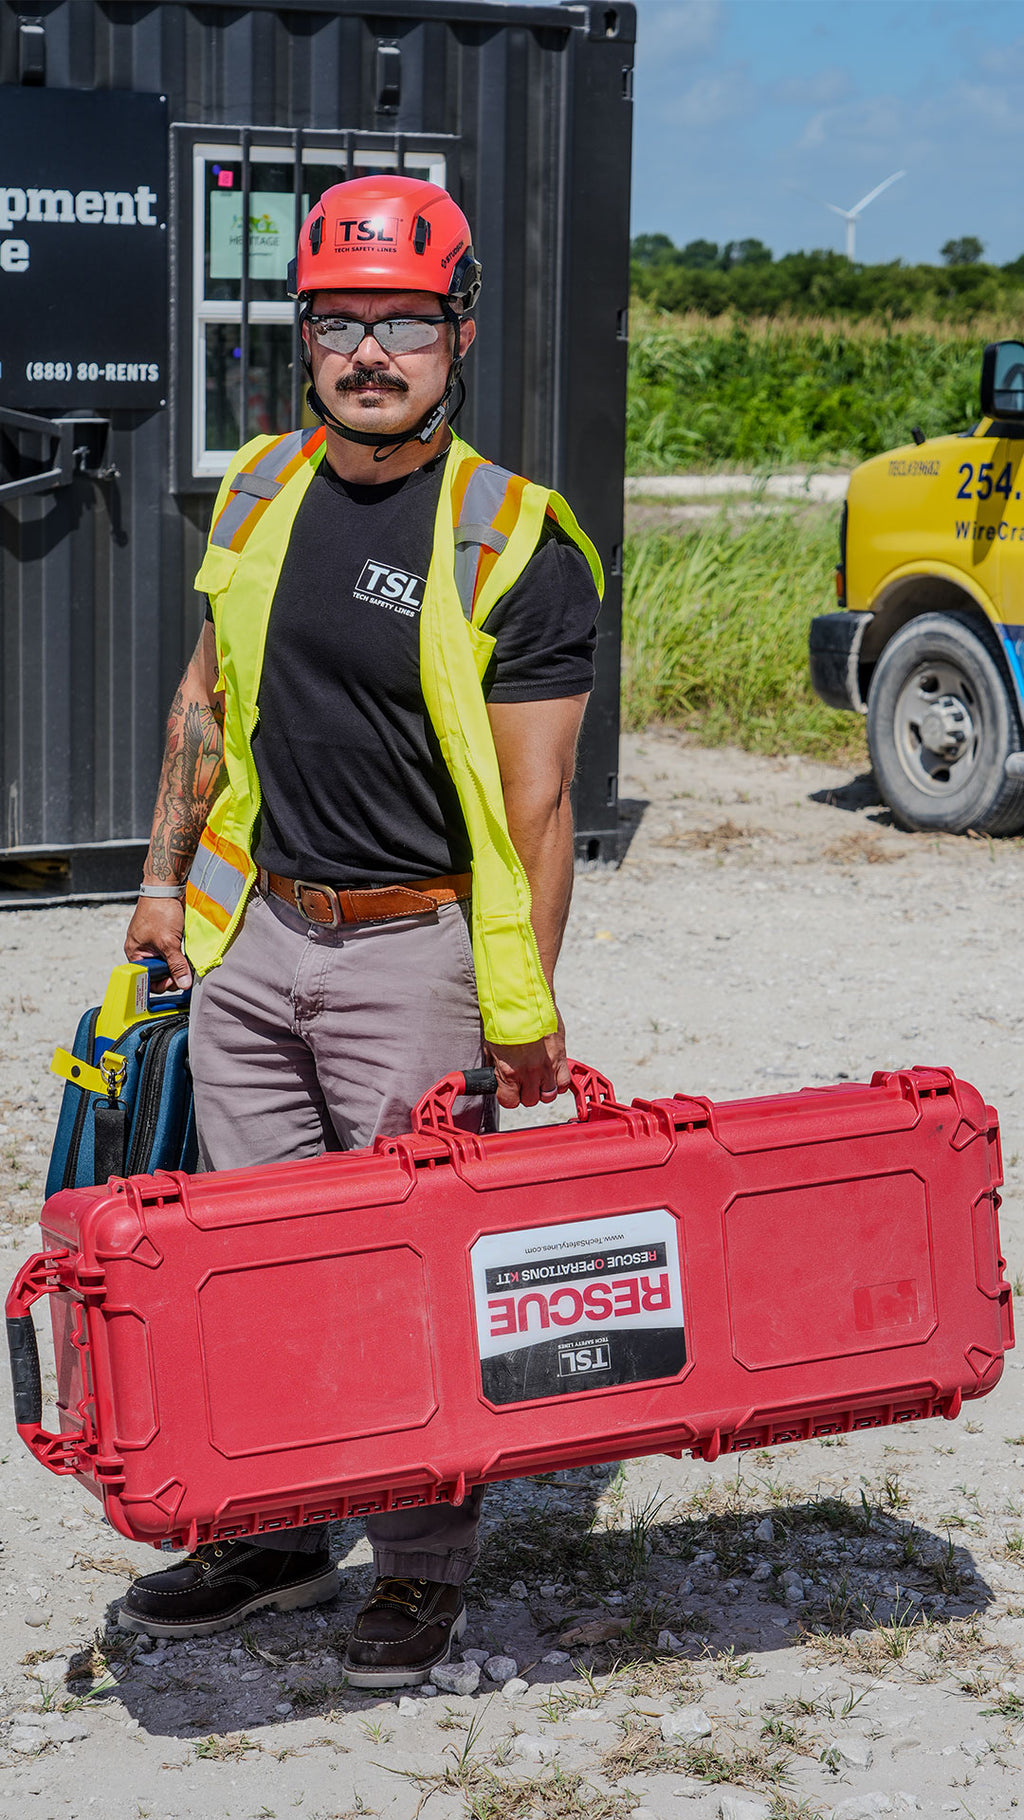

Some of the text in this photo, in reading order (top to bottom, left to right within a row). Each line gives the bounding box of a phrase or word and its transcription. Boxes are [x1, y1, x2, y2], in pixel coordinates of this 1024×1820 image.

[229, 235, 279, 247] HEITAGE
[339, 220, 393, 242] TSL
[26, 361, 160, 382] (888) 80-RENTS
[366, 564, 420, 606] TSL
[352, 592, 416, 618] TECH SAFETY LINES
[524, 1233, 625, 1254] www.TechSafetyLines.com
[496, 1250, 657, 1286] RESCUE OPERATIONS KIT
[487, 1273, 672, 1337] RESCUE
[574, 1339, 594, 1347] SAFETY
[561, 1348, 608, 1372] TSL
